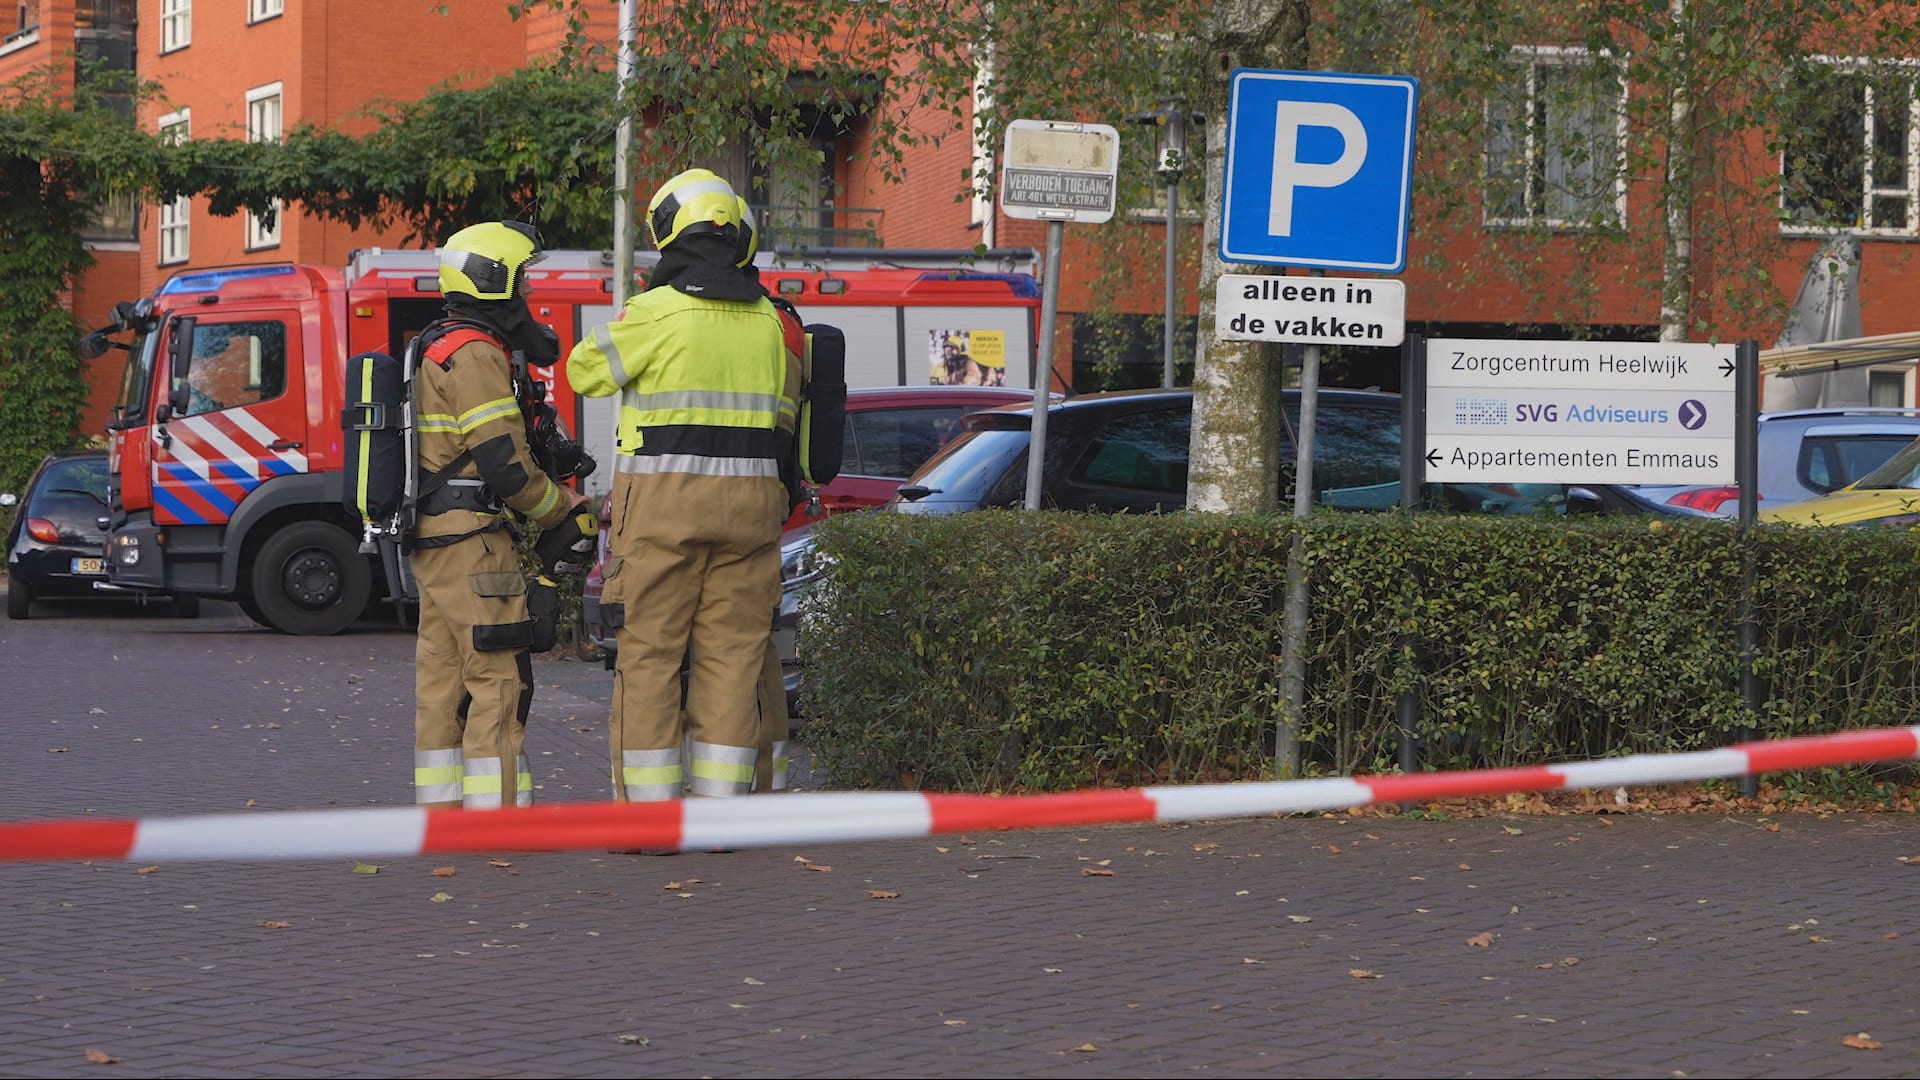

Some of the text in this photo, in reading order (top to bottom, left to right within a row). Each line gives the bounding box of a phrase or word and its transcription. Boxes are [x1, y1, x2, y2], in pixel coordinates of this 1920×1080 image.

[1268, 101, 1368, 237] P
[1008, 173, 1109, 195] VERBODEN TOEGANG
[1243, 279, 1373, 304] alleen in
[1229, 313, 1384, 340] de vakken
[1451, 351, 1689, 379] Zorgcentrum Heelwijk
[1515, 403, 1669, 424] SVG Adviseurs
[1450, 447, 1720, 470] Appartementen Emmaus
